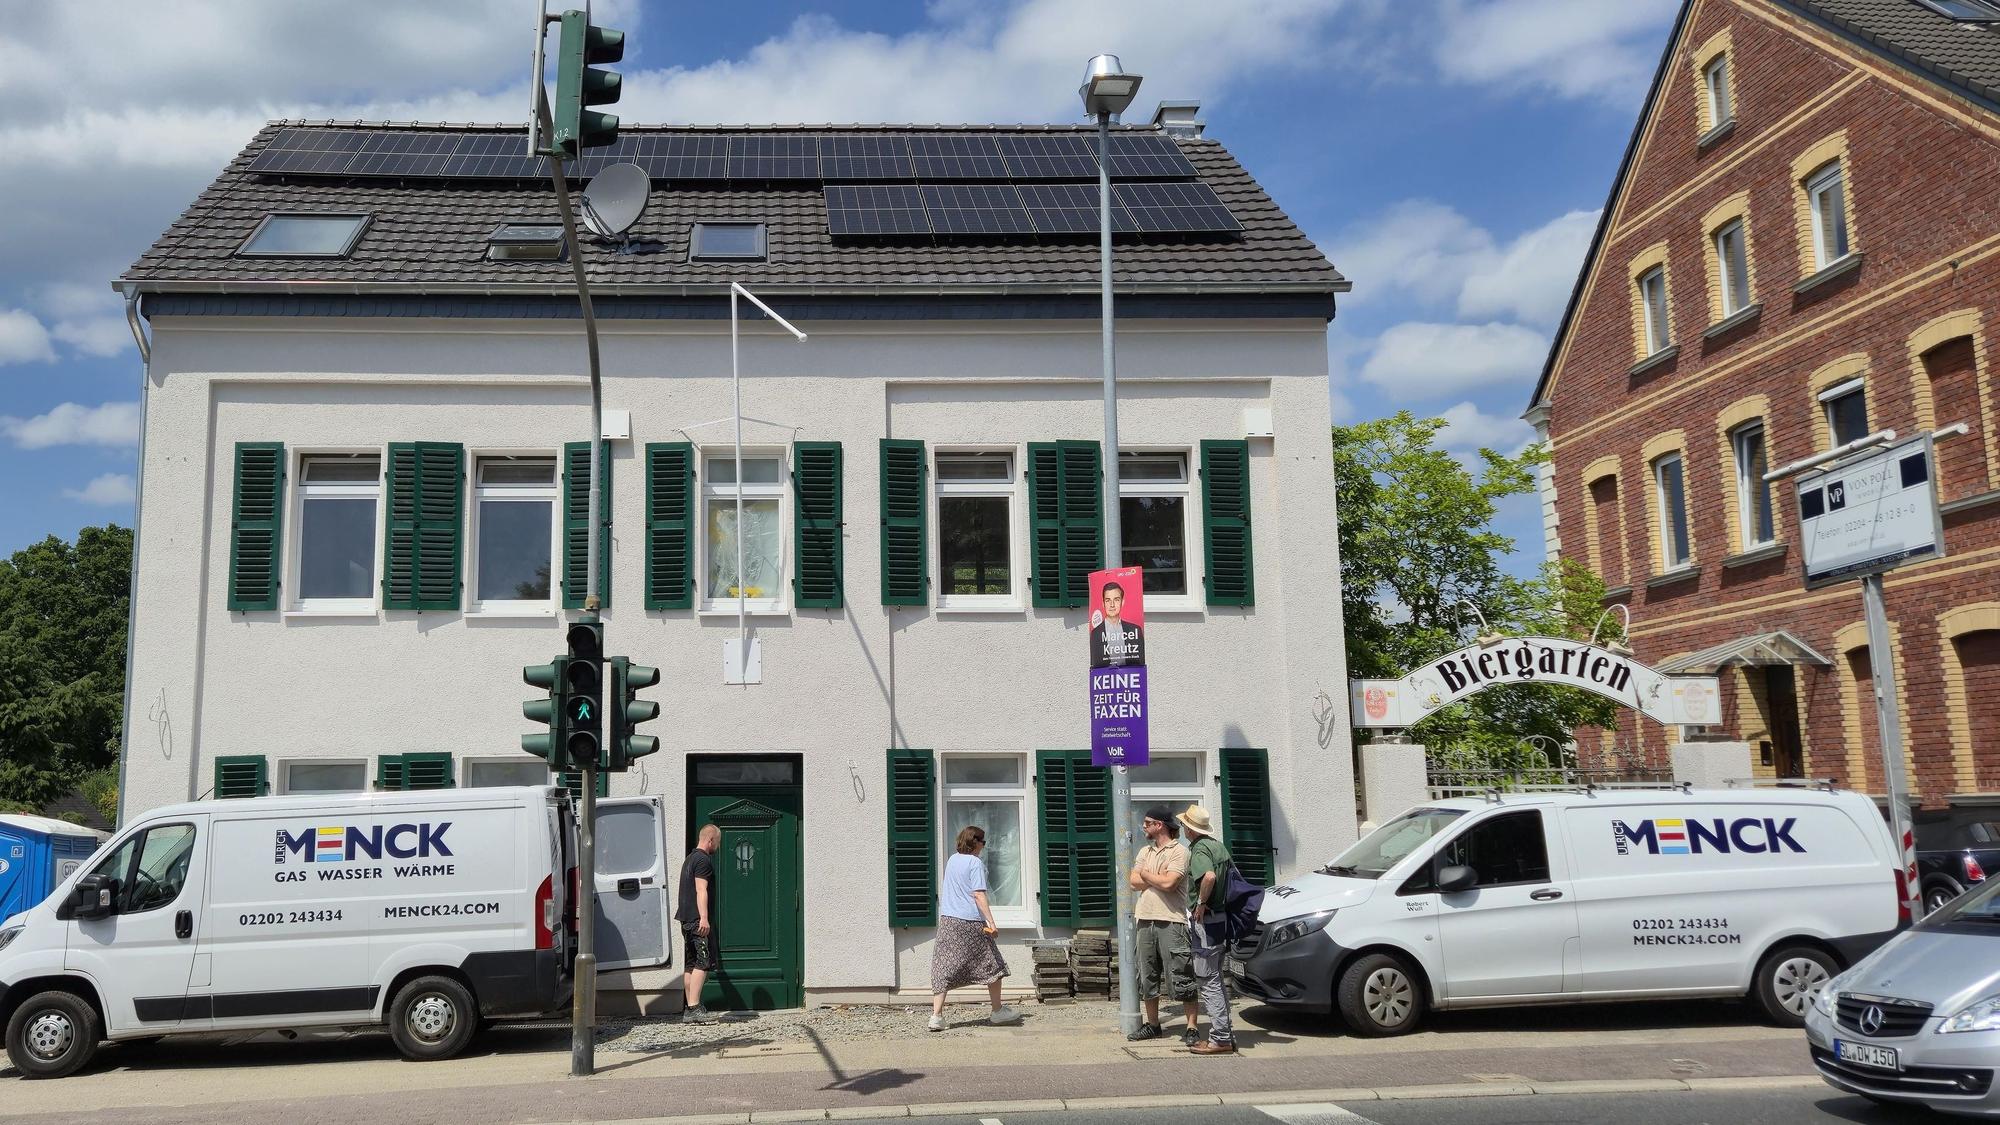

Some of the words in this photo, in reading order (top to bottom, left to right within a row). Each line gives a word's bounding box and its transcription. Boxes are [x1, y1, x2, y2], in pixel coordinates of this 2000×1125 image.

[1101, 628, 1139, 643] Marcel
[1103, 643, 1139, 656] Kreutz
[1435, 640, 1632, 694] Biergarten
[1093, 673, 1141, 691] KEINE
[1093, 693, 1114, 705] ZEIT
[1116, 690, 1141, 703] FÜR
[1094, 704, 1142, 720] FAXEN
[1107, 746, 1125, 756] Volt
[284, 822, 455, 863] MENCK
[1611, 819, 1629, 855] ULRICH
[1620, 817, 1808, 855] MENCK
[275, 829, 287, 864] ULRICH
[65, 865, 79, 876] DIX
[274, 871, 307, 883] GAS
[317, 867, 383, 881] WASSER
[393, 864, 456, 878] WÄRME
[239, 913, 285, 926] 02202
[289, 910, 343, 924] 243434
[384, 902, 500, 918] MENCK24.COM
[1632, 919, 1675, 930] 02202
[1679, 918, 1729, 930] 243434
[1633, 934, 1742, 946] MENCK24.COM
[1840, 1042, 1851, 1059] GL
[1857, 1046, 1870, 1063] DW
[1873, 1049, 1894, 1066] 150
